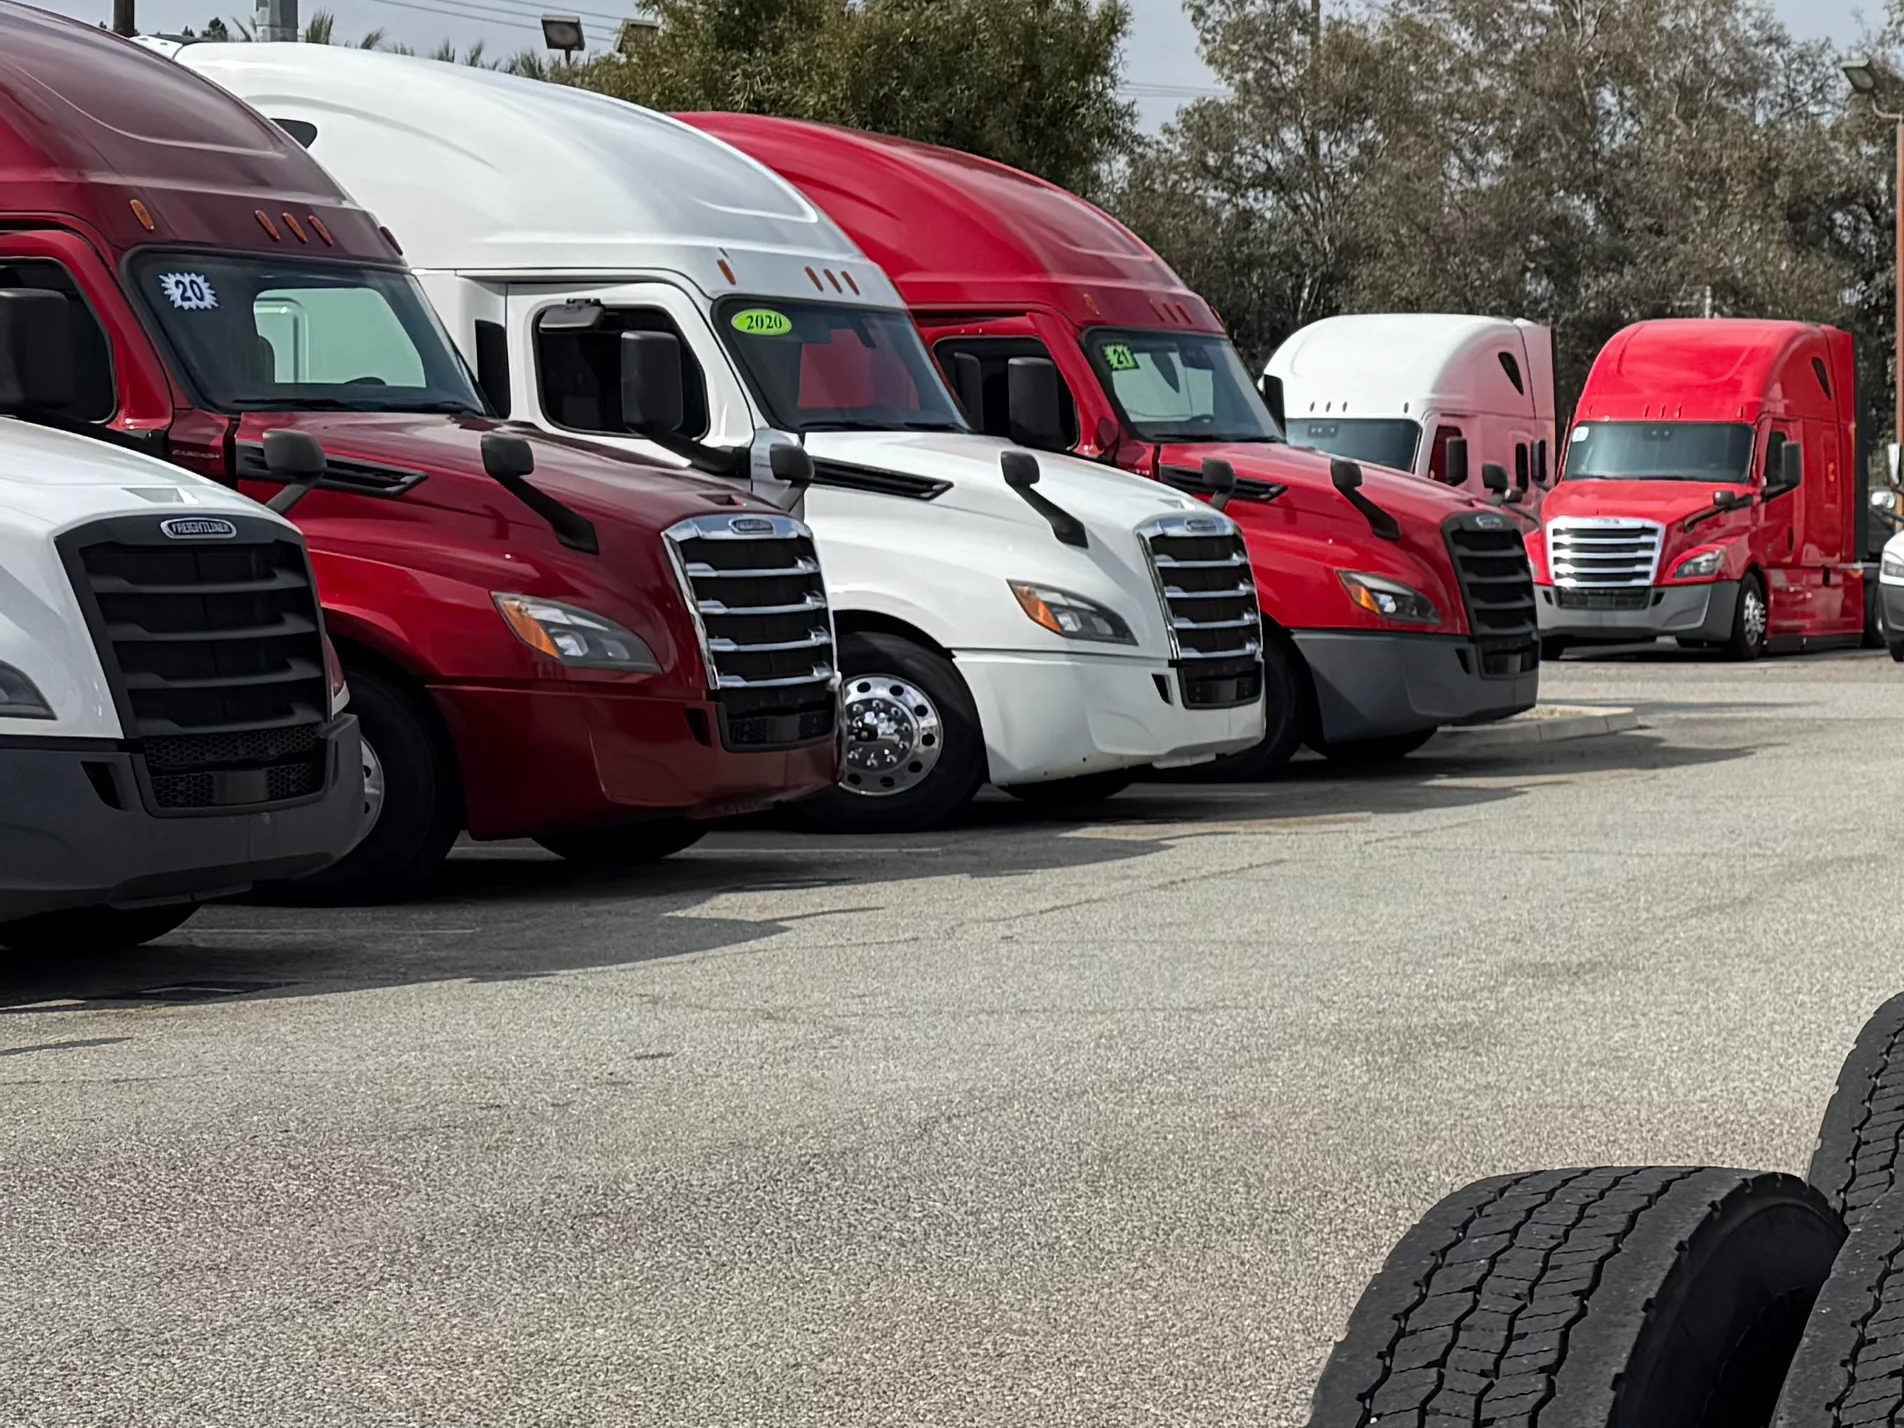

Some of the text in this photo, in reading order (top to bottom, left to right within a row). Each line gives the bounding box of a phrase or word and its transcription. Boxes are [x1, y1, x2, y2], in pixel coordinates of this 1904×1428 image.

[175, 279, 205, 302] 20
[745, 315, 783, 329] 2020
[1113, 349, 1130, 365] 21
